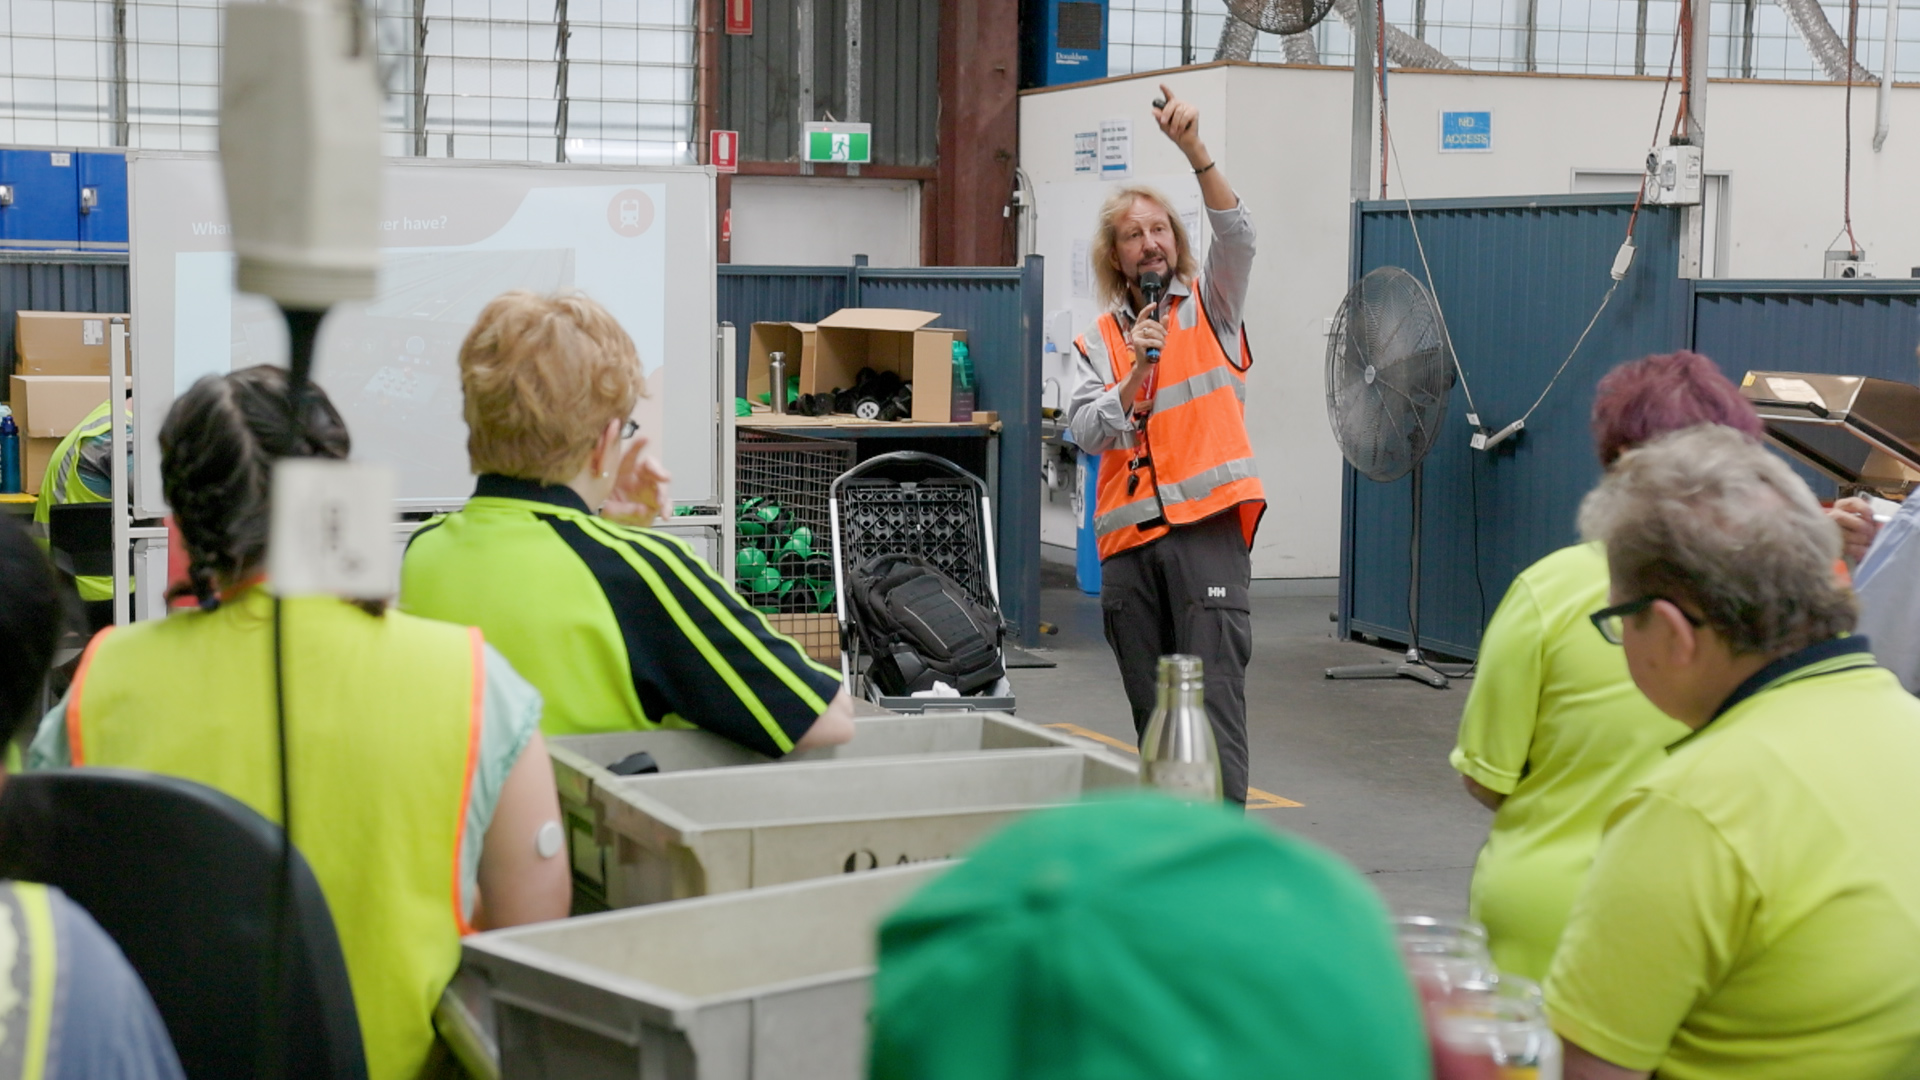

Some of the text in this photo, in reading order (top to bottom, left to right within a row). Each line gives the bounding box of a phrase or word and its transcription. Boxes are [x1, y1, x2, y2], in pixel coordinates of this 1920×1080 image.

[1458, 117, 1474, 127] NO
[1445, 133, 1488, 144] ACCESS
[403, 215, 448, 230] have?
[1208, 586, 1226, 597] HH
